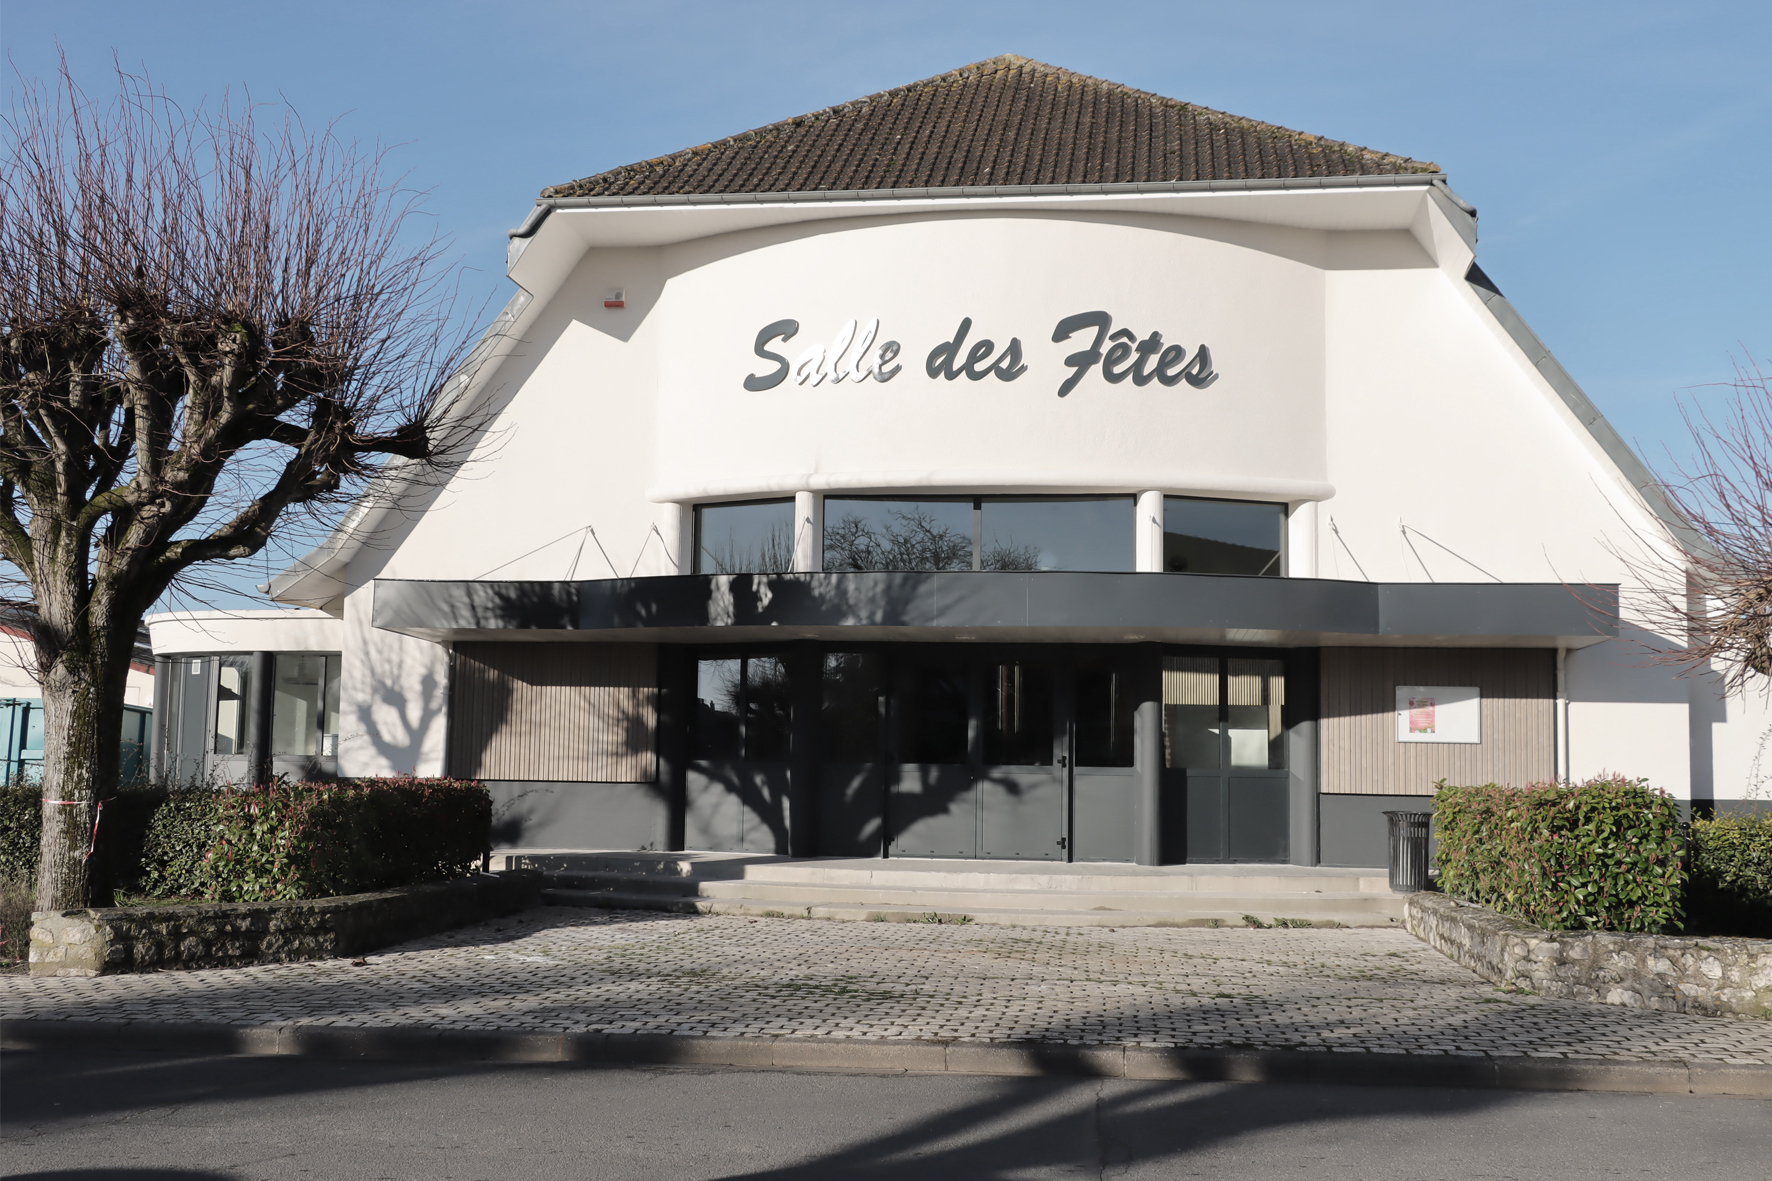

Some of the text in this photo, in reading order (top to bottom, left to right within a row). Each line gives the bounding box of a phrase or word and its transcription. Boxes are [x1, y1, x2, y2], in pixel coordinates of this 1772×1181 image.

[743, 310, 1217, 398] Salle des Fêtes
